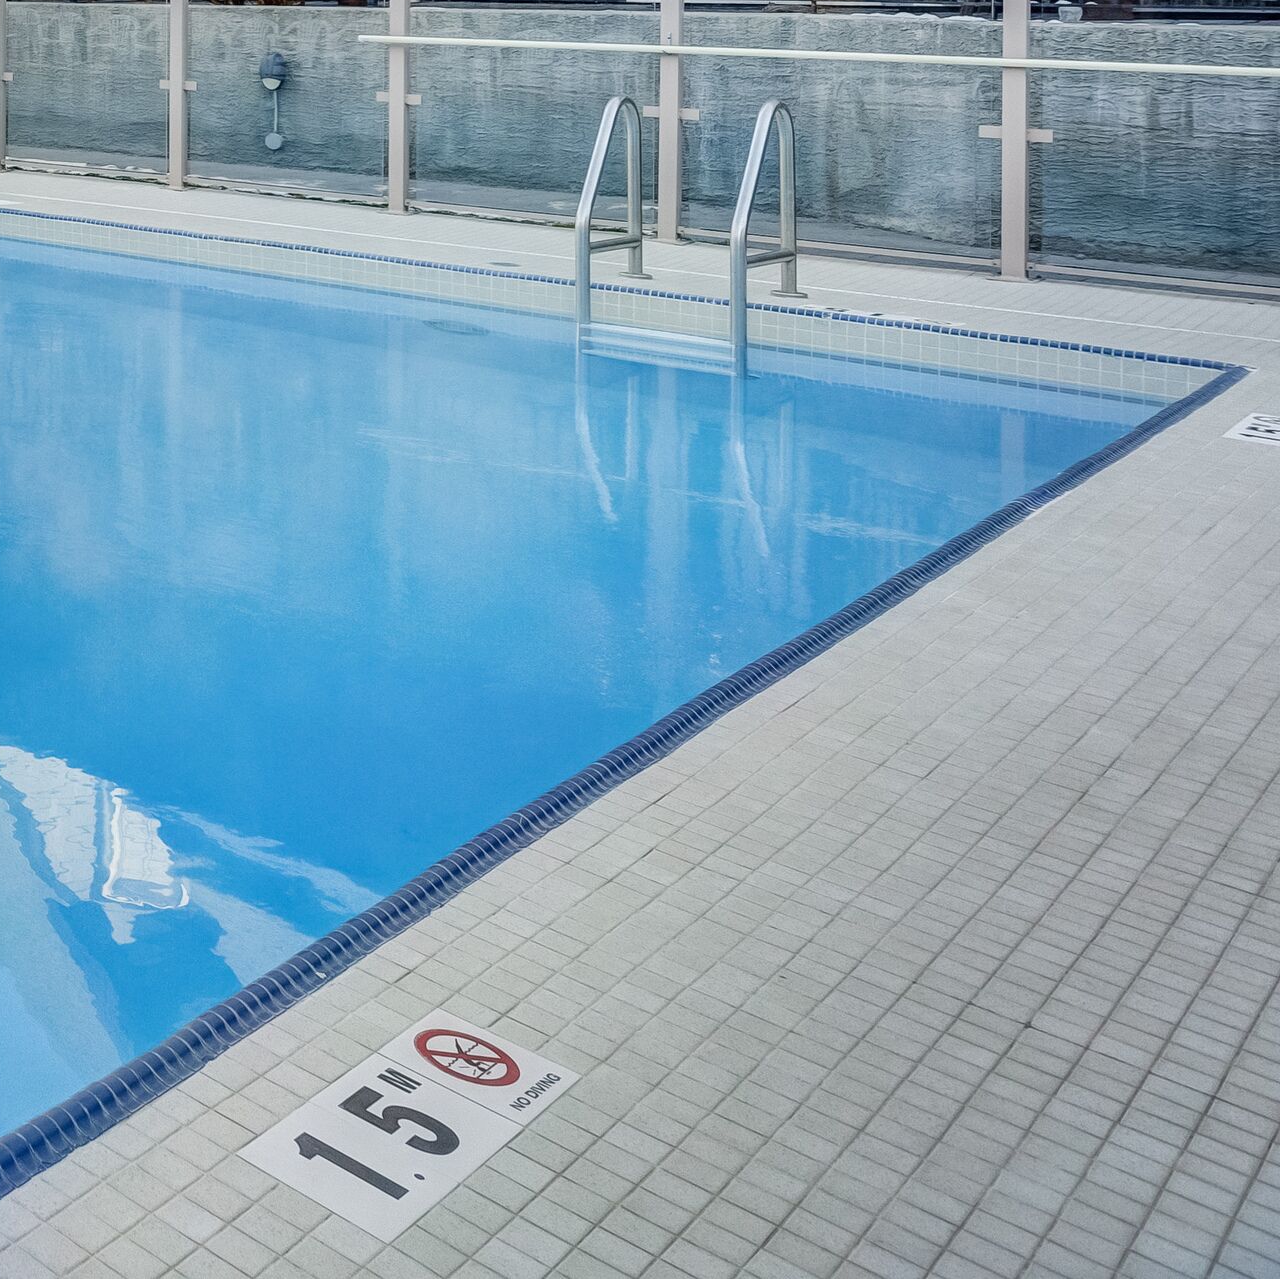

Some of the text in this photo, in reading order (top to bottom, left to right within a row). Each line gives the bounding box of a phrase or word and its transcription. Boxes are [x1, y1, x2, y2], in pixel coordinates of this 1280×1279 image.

[509, 1073, 562, 1111] NO DIVING
[294, 1085, 460, 1201] 1.5
